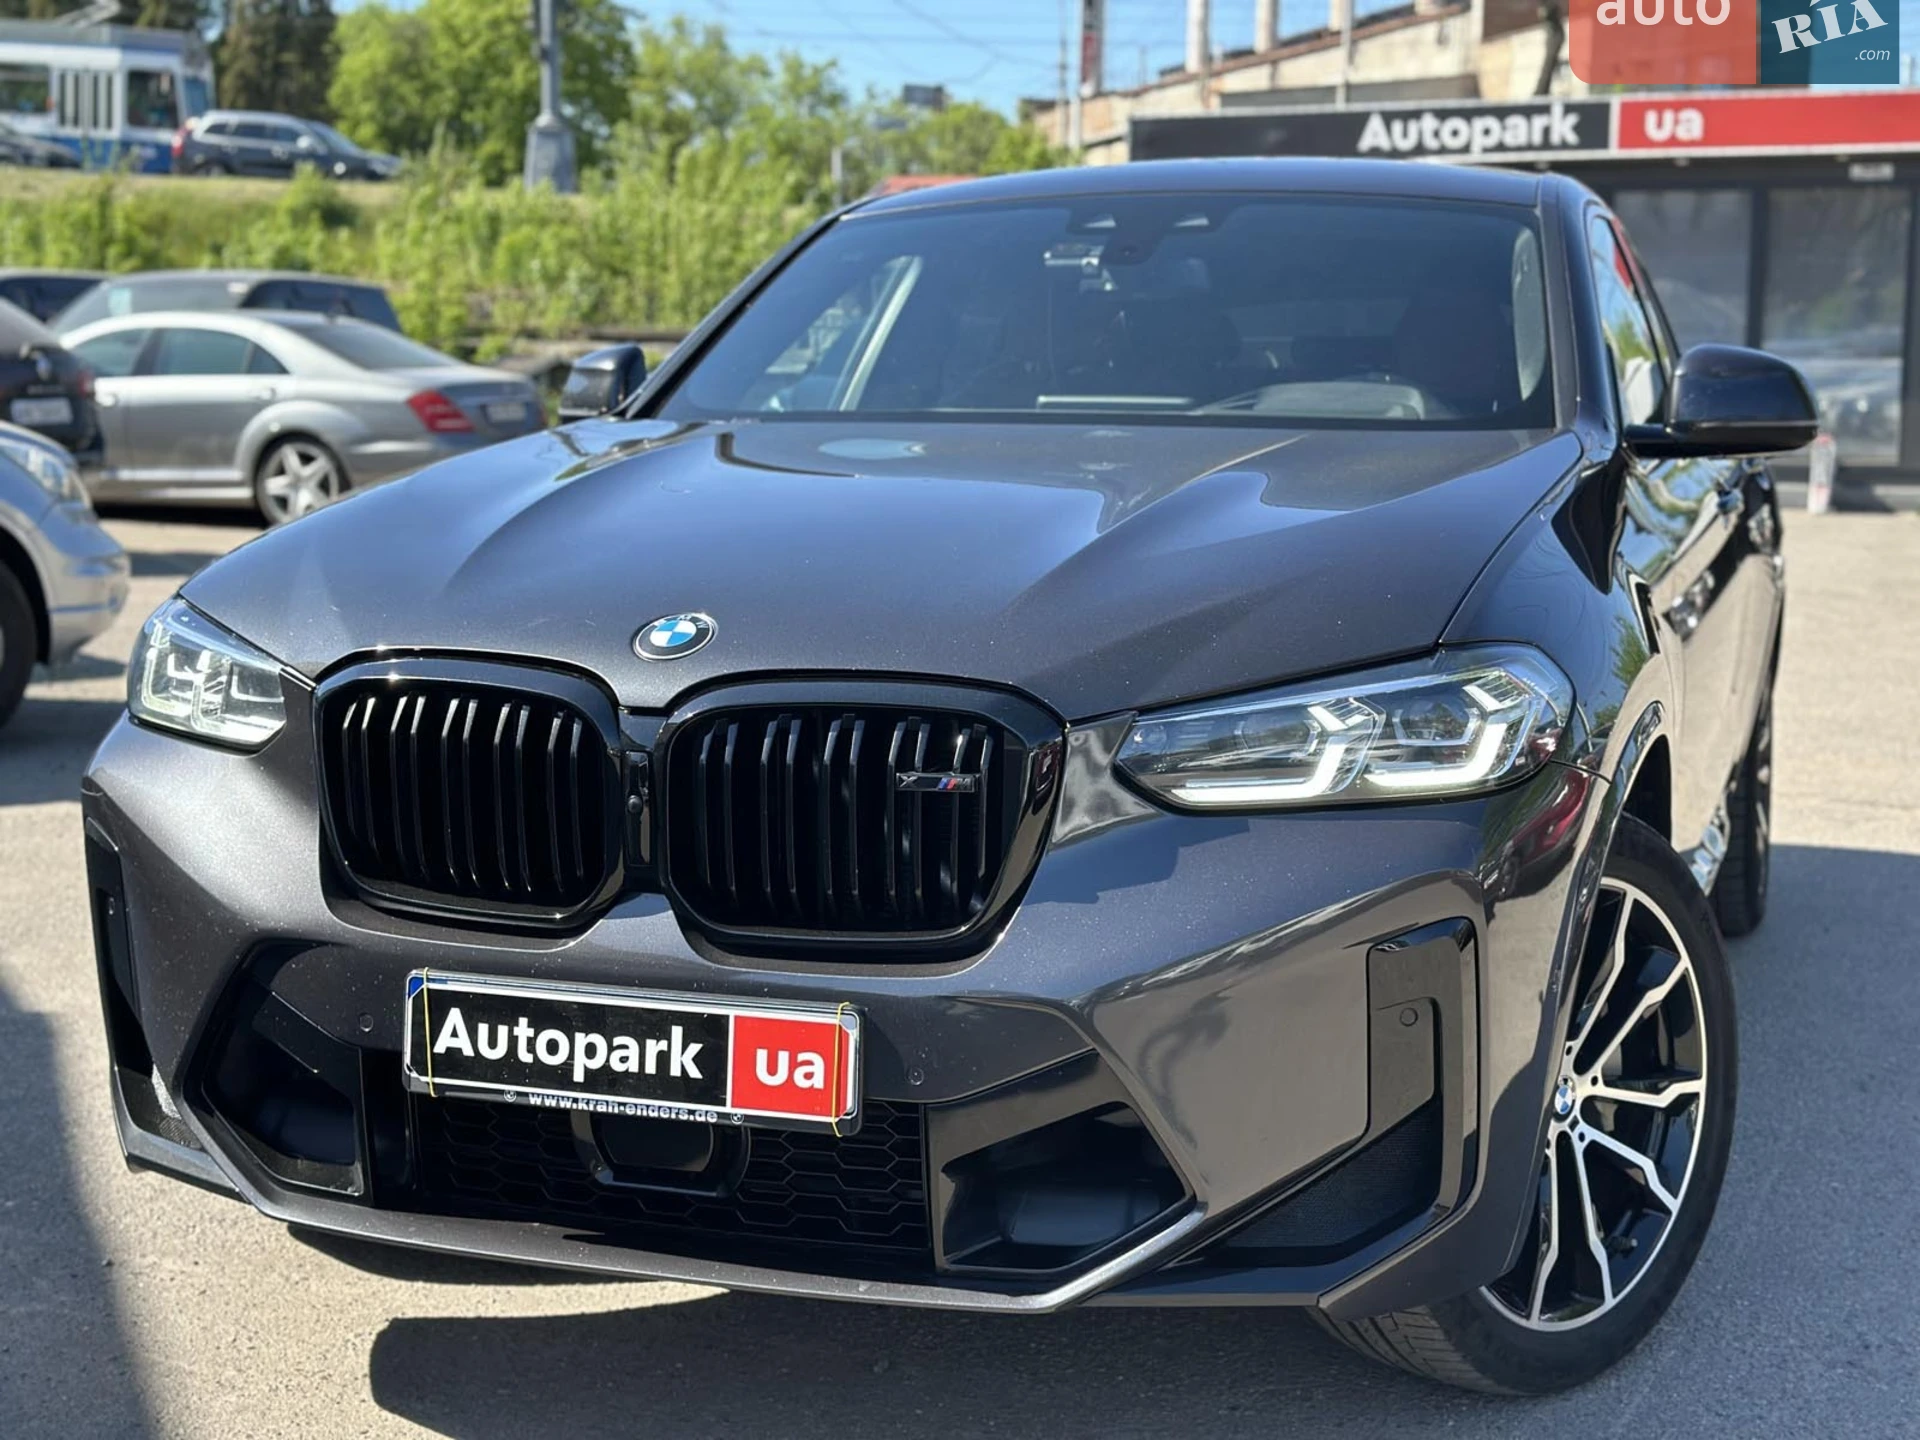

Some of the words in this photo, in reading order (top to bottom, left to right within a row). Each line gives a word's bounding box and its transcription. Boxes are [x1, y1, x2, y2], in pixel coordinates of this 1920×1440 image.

[1356, 100, 1580, 155] Autopark
[1644, 106, 1704, 142] ua
[433, 1007, 704, 1083] Autopark
[754, 1046, 825, 1090] ua
